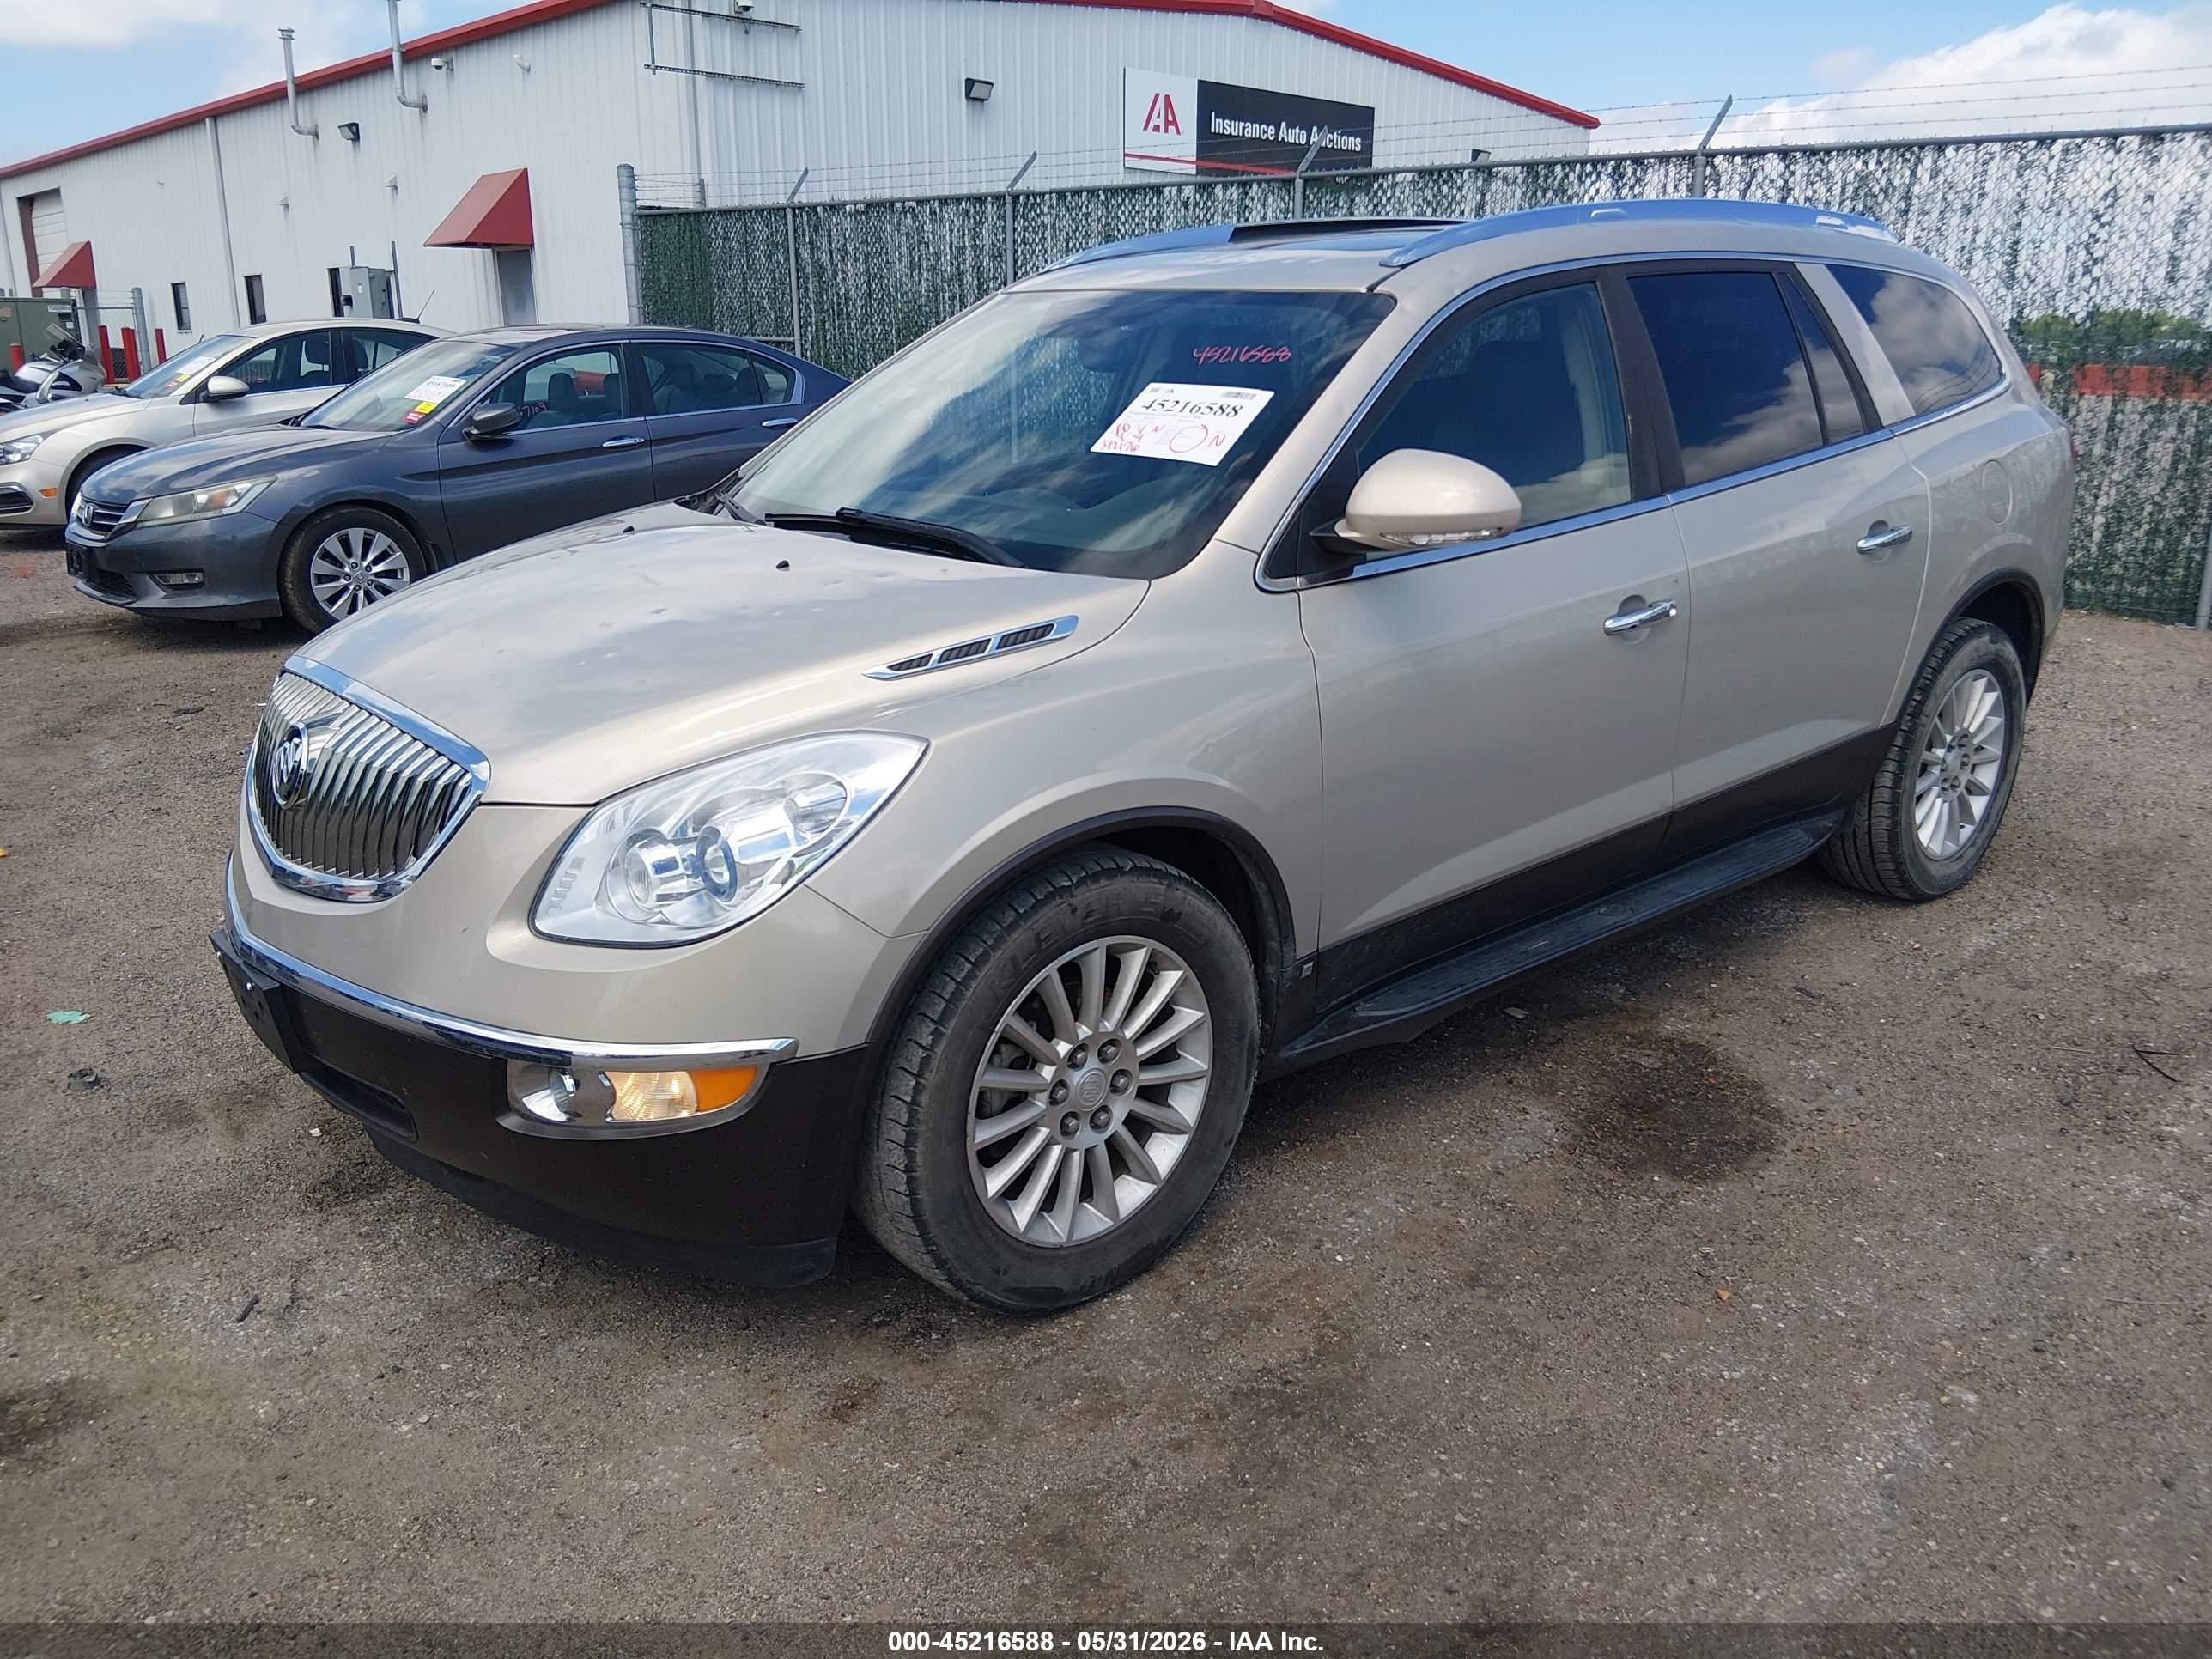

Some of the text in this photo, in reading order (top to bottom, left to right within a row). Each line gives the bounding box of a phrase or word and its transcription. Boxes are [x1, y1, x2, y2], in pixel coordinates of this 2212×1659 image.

[1211, 112, 1275, 141] Insurance
[1279, 122, 1307, 145] Auto
[1194, 345, 1291, 366] 45216588
[1141, 398, 1243, 418] 45216588
